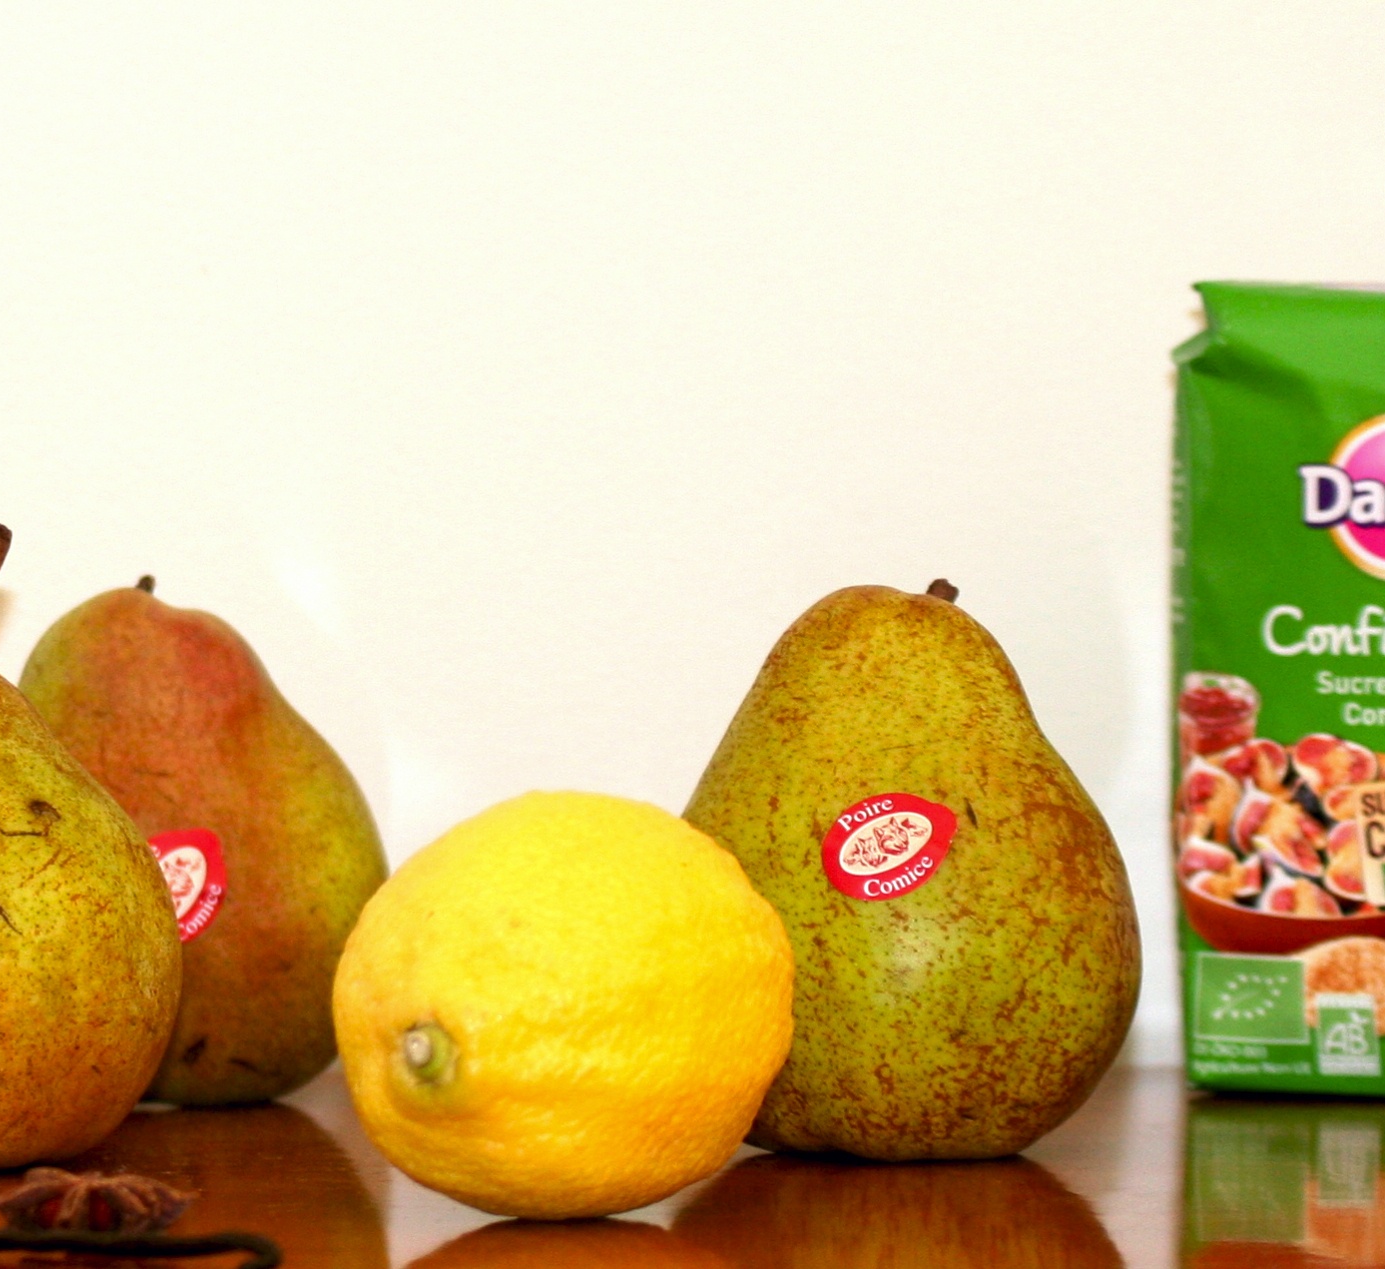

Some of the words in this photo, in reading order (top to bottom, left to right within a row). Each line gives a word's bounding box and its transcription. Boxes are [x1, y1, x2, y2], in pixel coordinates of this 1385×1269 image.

[1298, 463, 1385, 527] Da
[1317, 670, 1385, 694] Sucre
[838, 799, 894, 832] Poire
[864, 856, 933, 897] Comice
